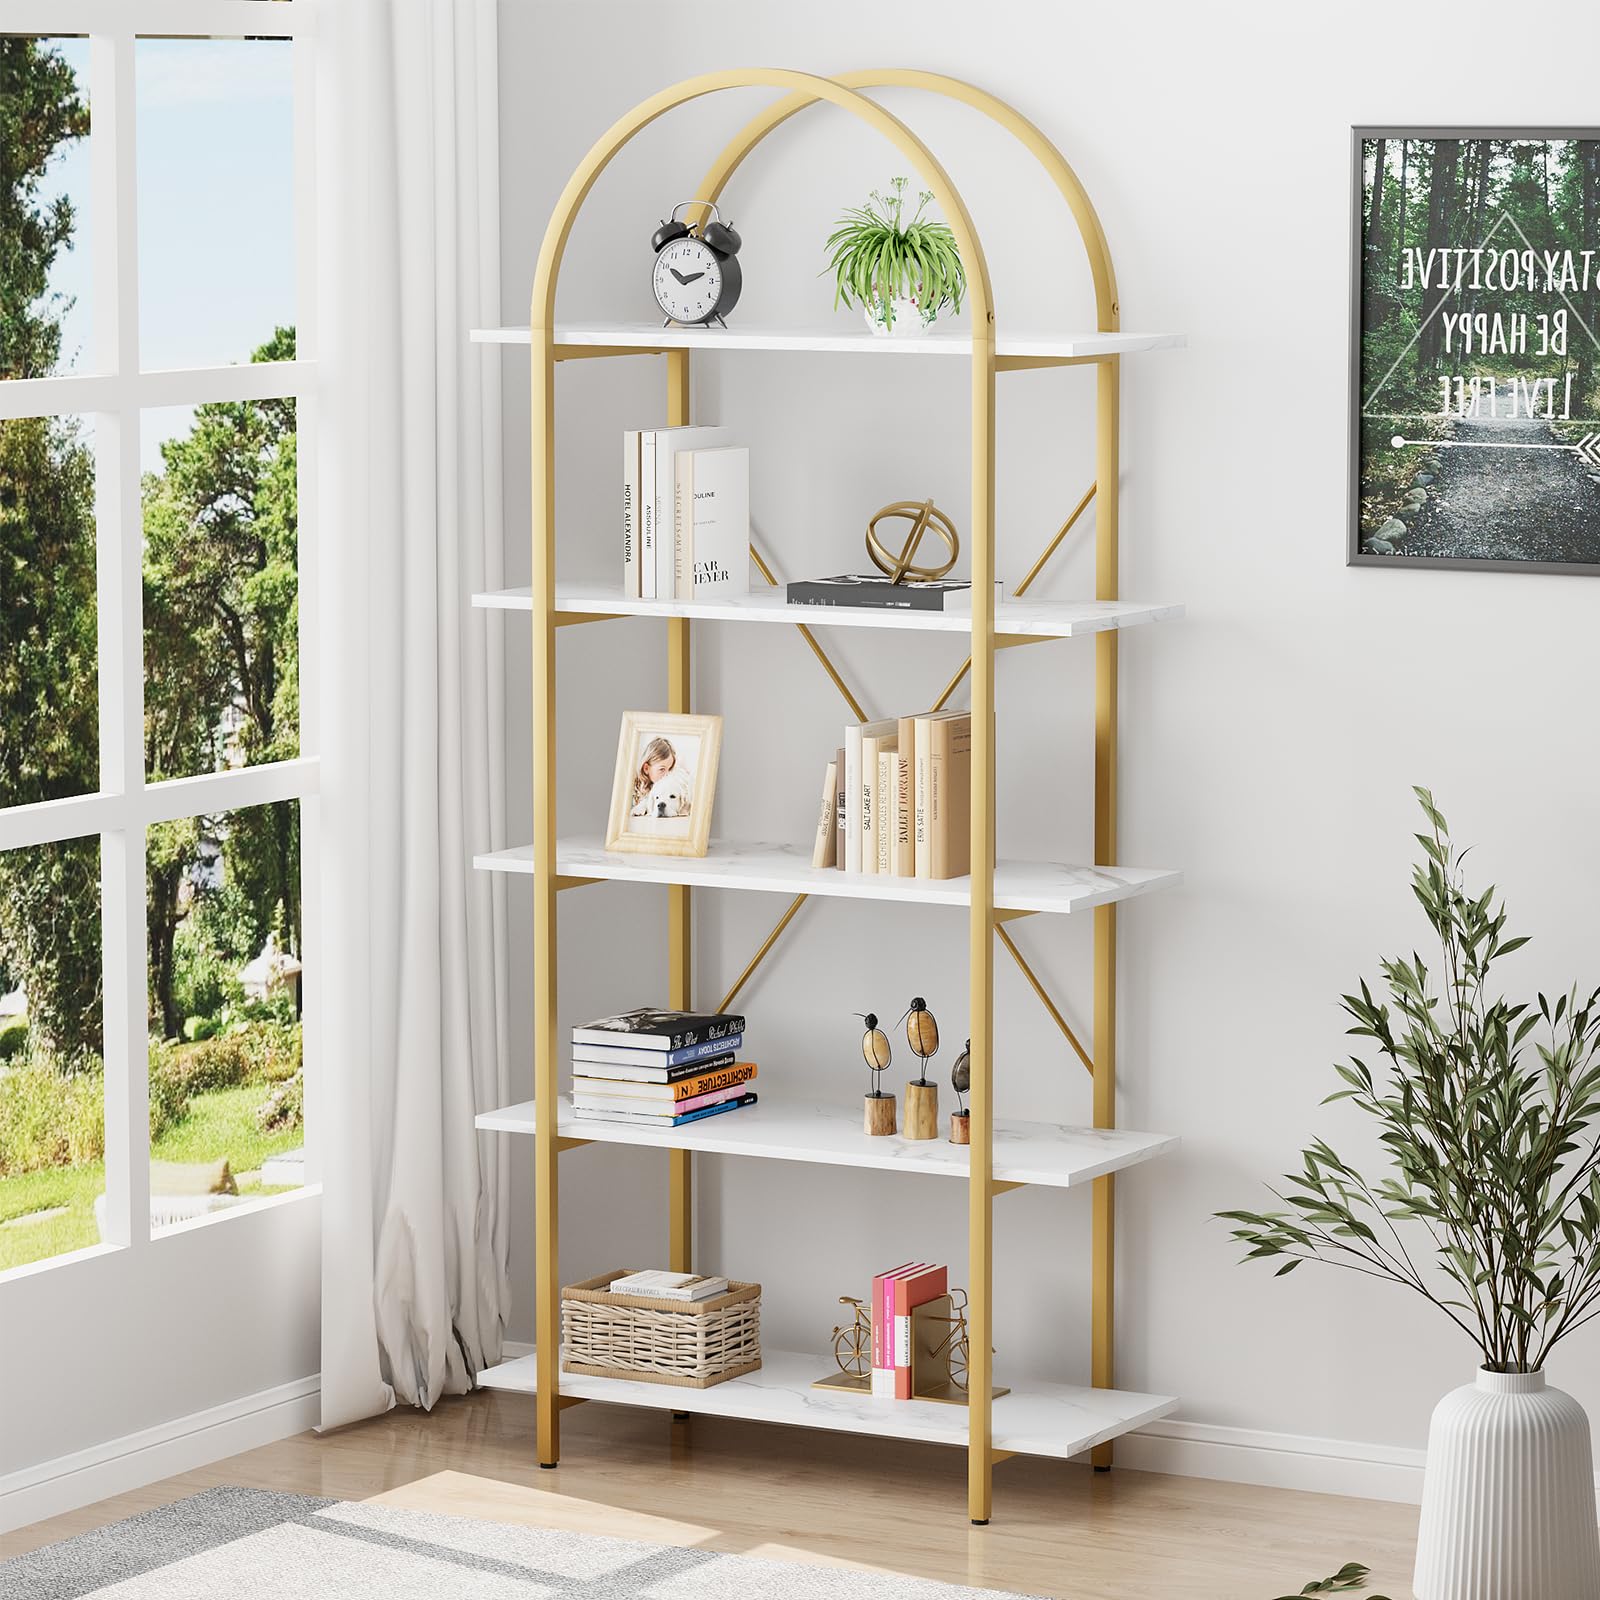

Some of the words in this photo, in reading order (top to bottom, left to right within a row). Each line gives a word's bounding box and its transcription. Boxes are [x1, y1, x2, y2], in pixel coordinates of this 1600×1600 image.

[682, 248, 691, 256] 12
[697, 251, 701, 259] 1
[662, 262, 670, 270] 10
[709, 277, 714, 285] 3
[663, 291, 668, 299] 8
[671, 301, 676, 309] 7
[697, 301, 702, 309] 5
[624, 484, 632, 511] HOTEL
[625, 512, 633, 564] ALEXANDRA
[879, 760, 887, 804] RETROVISEUR
[898, 757, 909, 806] LORRAINE
[863, 784, 872, 798] ART
[864, 798, 872, 815] LAKE
[864, 814, 872, 831] SALT
[899, 806, 909, 843] BALLET
[917, 807, 925, 827] SATIE
[917, 827, 925, 843] ERIK
[879, 833, 887, 857] CHIENS
[879, 858, 888, 869] LES
[697, 1045, 714, 1056] TODAY
[712, 1036, 741, 1051] ARCHITECTS
[697, 1066, 753, 1093] ARCHITECTURE
